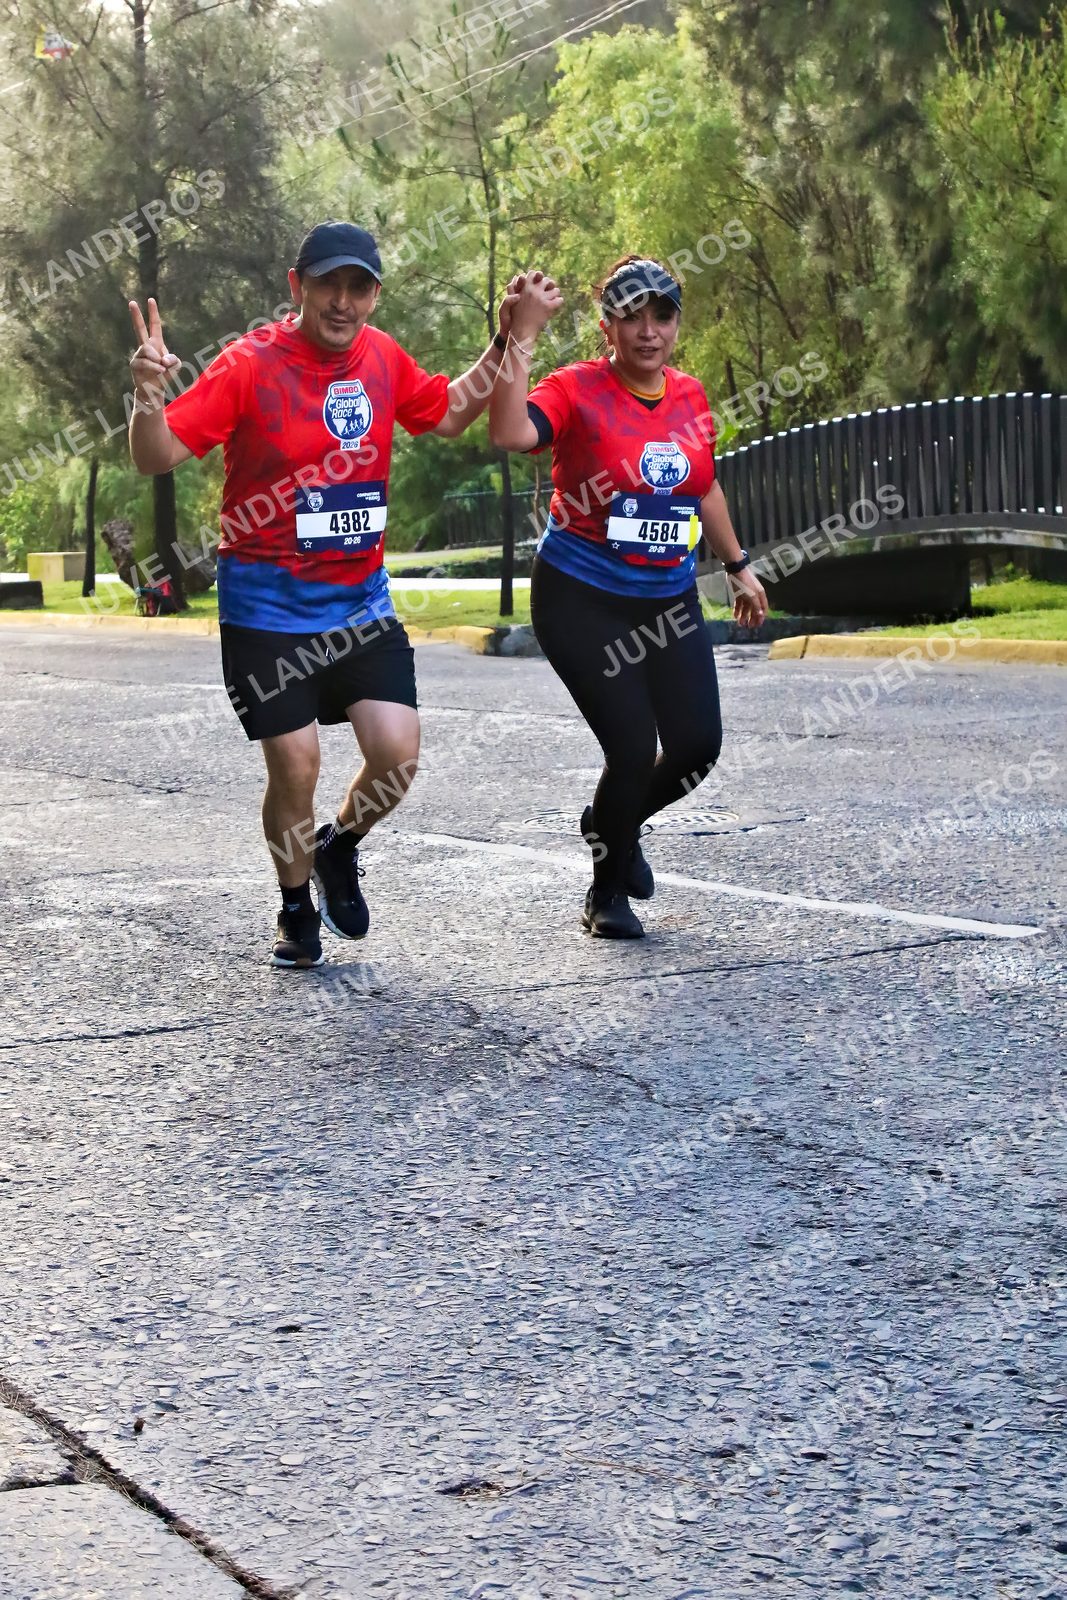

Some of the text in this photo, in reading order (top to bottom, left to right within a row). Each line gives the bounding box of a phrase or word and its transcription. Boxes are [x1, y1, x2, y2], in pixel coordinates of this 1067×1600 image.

[334, 386, 359, 395] BIMBO
[332, 408, 353, 419] Race
[342, 441, 359, 449] 2026
[652, 455, 677, 463] Global
[648, 462, 669, 470] Race
[329, 510, 371, 534] 4382
[638, 521, 679, 542] 4584
[344, 536, 361, 545] 20-26
